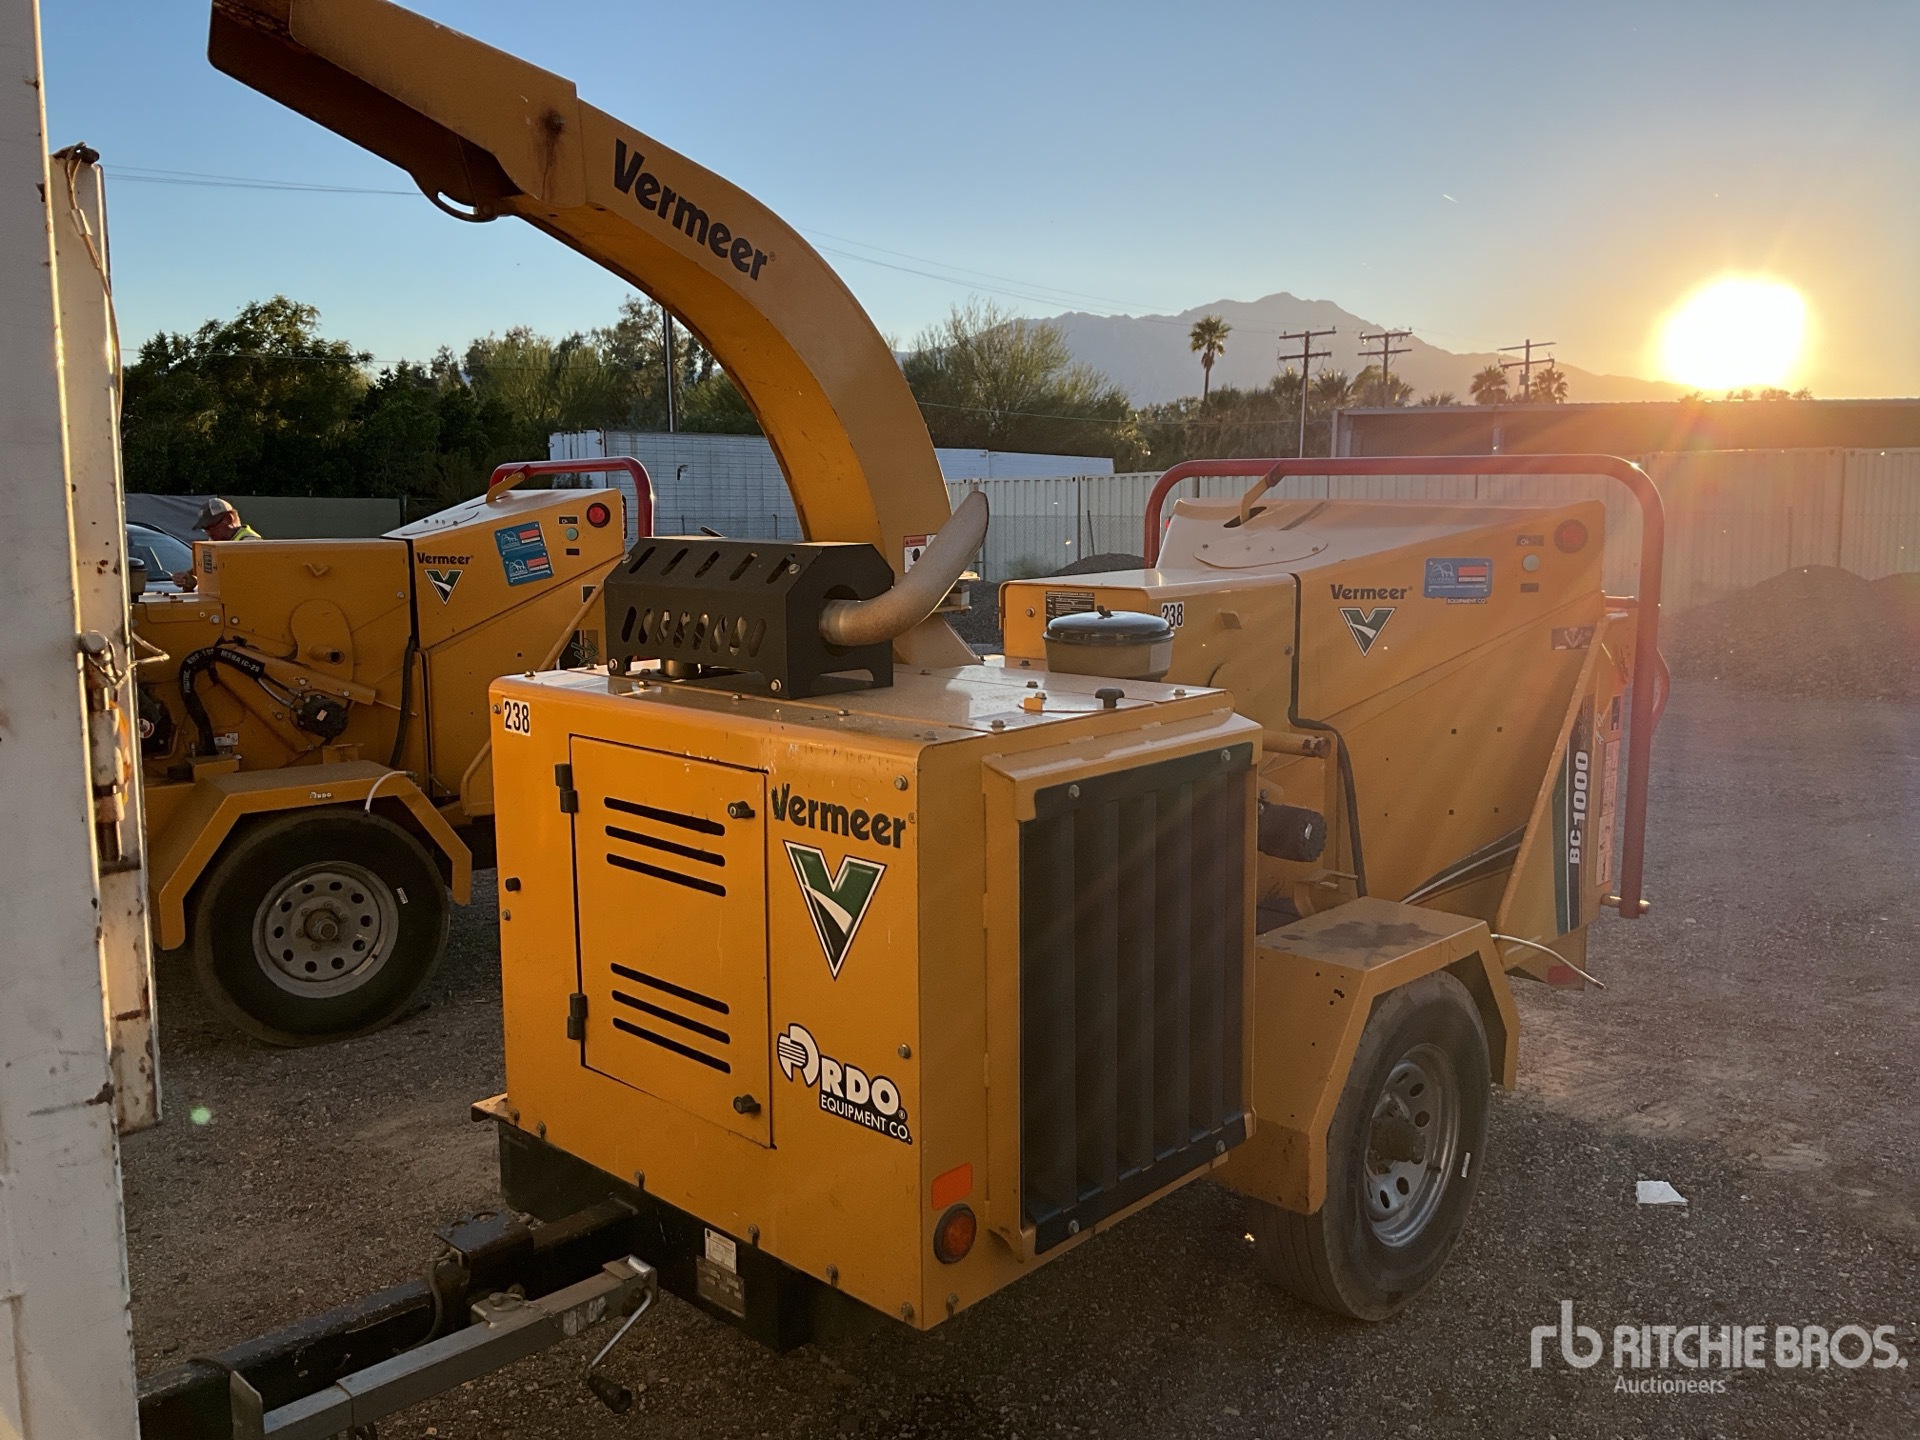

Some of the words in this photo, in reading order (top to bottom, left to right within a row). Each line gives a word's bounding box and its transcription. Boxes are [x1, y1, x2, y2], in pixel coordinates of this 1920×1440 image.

[614, 138, 767, 281] Vermeer
[416, 552, 470, 565] Vermeer
[1330, 584, 1408, 600] Vermeer
[1162, 603, 1184, 628] 238
[504, 700, 530, 733] 238
[771, 783, 906, 849] Vermeer
[820, 1093, 887, 1132] EQUIPMENT
